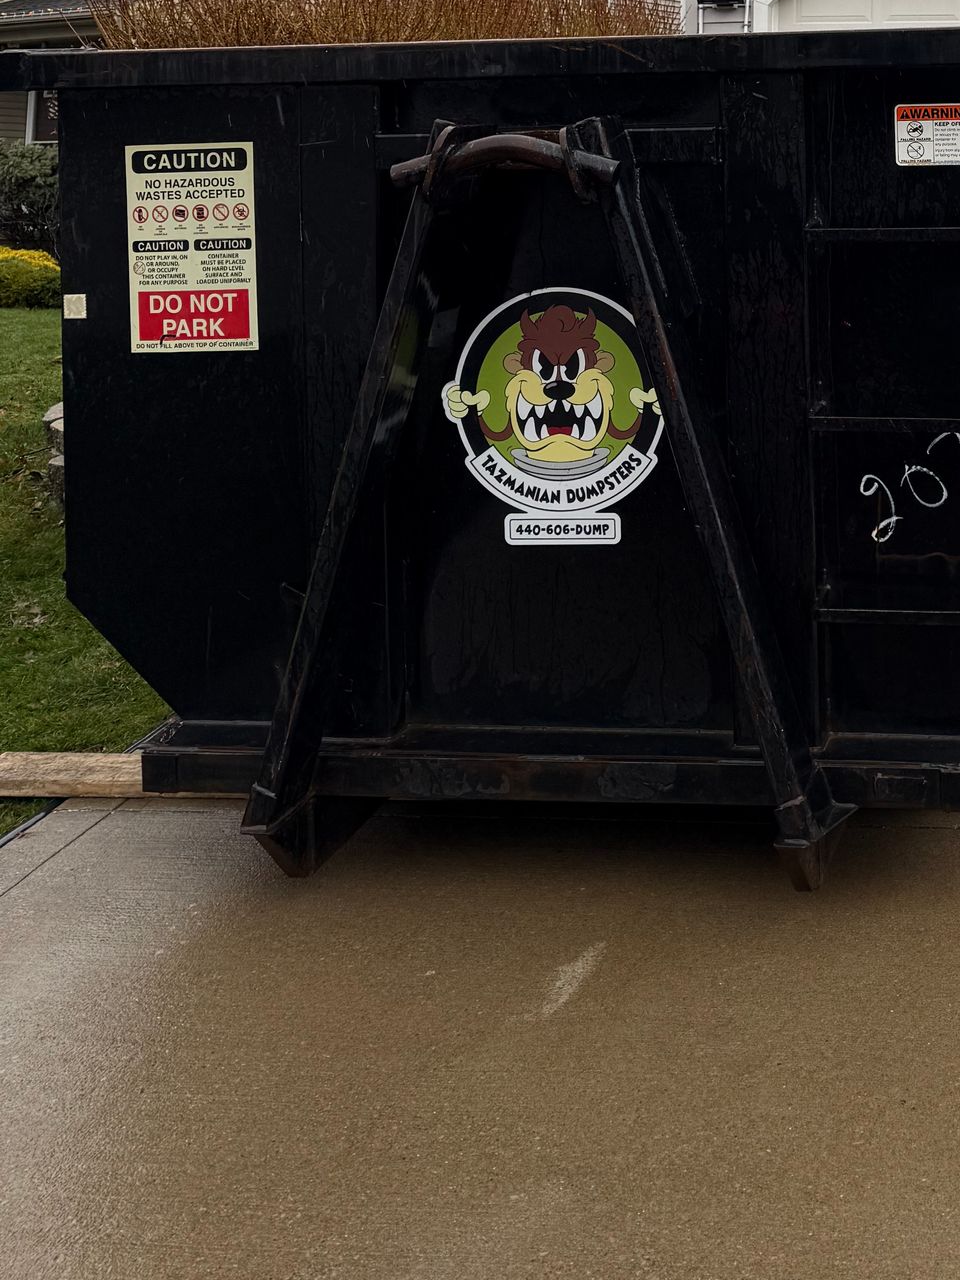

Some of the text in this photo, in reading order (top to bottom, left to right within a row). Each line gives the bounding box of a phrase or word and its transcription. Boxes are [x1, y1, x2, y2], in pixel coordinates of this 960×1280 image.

[144, 152, 236, 170] CAUTION
[145, 177, 235, 189] NO HAZARDOUS
[136, 189, 245, 200] WASTES ACCEPTED
[138, 242, 184, 251] CAUTION
[200, 240, 246, 249] CAUTION
[149, 293, 237, 314] DO NOT
[162, 318, 224, 337] PARK
[480, 453, 643, 504] TAZMANIAN DUMPSTERS
[516, 524, 609, 536] 440-606-DUMP
